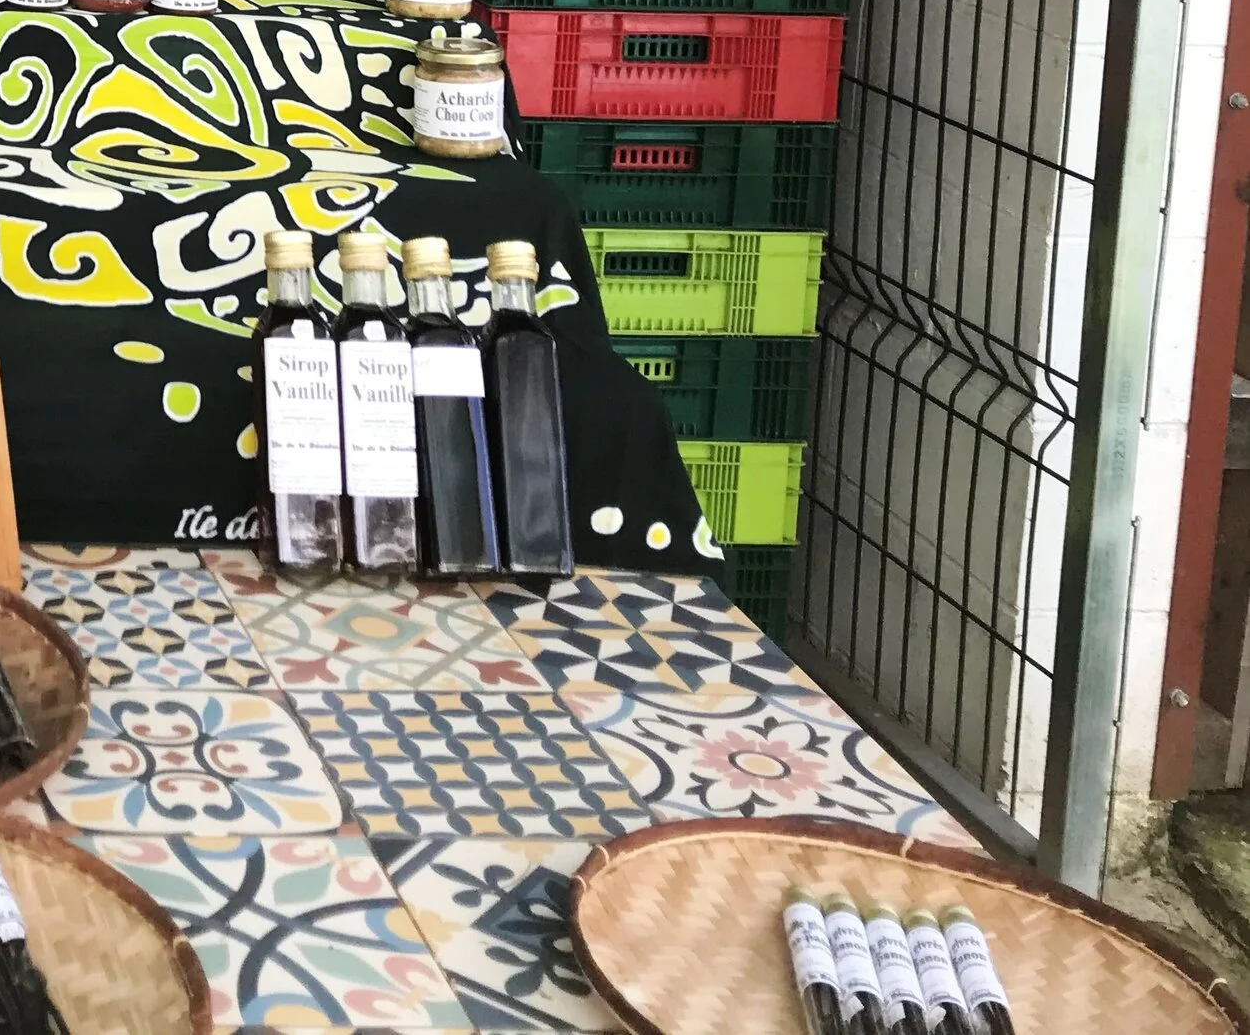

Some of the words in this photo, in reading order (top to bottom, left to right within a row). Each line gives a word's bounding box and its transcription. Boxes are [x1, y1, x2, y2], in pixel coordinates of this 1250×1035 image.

[436, 90, 494, 107] Achards
[435, 107, 466, 123] Chou
[279, 354, 329, 378] Sirop
[358, 358, 408, 381] Sirop
